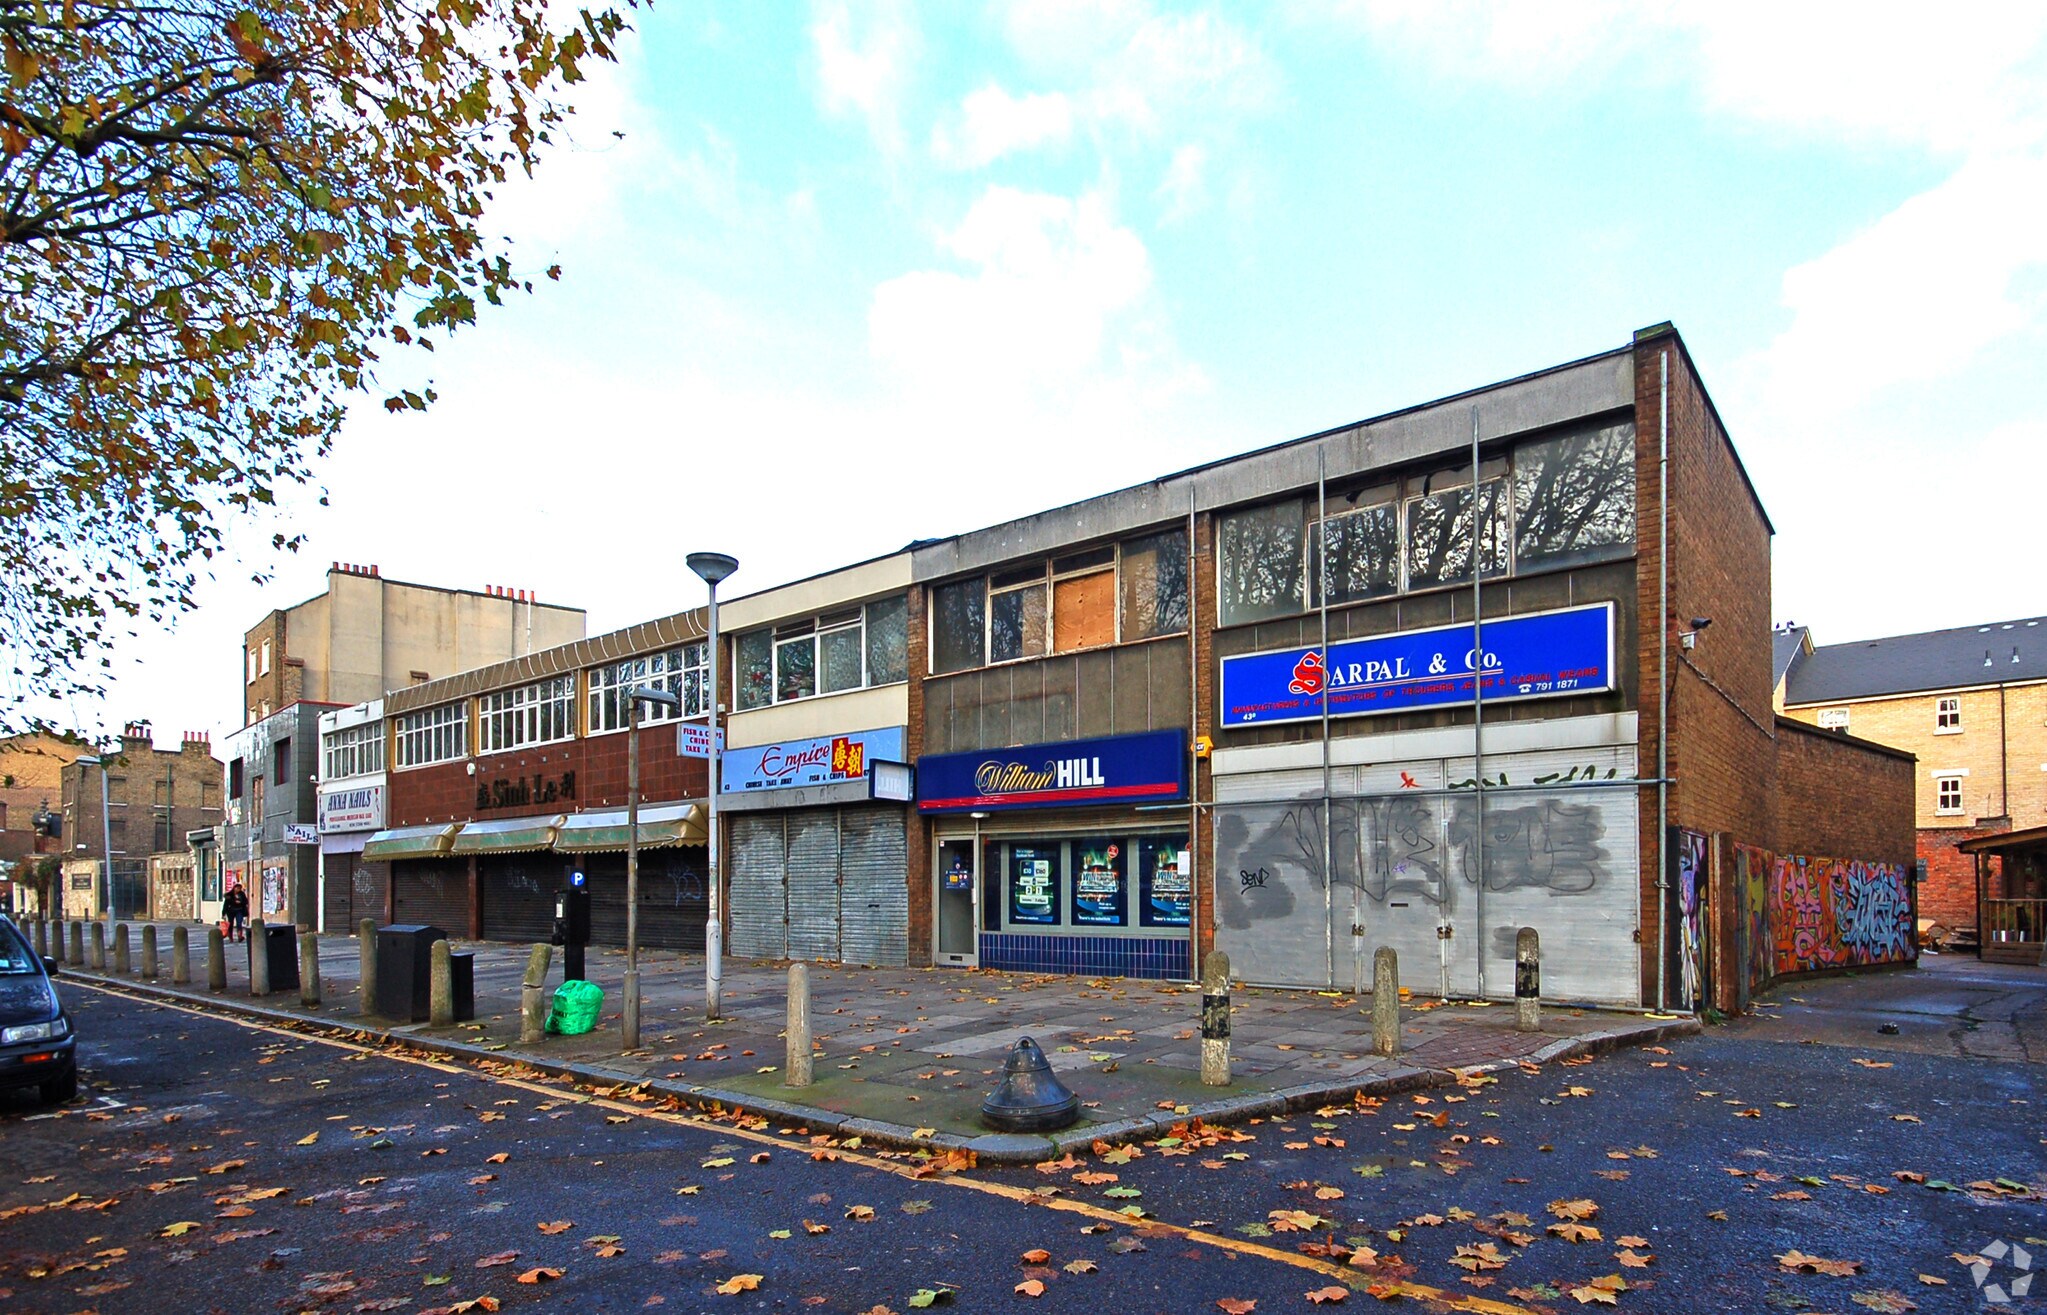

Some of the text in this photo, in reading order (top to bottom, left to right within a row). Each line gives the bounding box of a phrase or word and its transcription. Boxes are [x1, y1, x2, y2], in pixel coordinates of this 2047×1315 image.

[1288, 649, 1502, 695] SARPAL & Co.
[1536, 679, 1578, 691] 791 1871
[683, 728, 697, 736] FISH
[685, 745, 700, 753] TAKE
[754, 743, 830, 776] Empire
[975, 757, 1104, 795] William HILL
[327, 790, 371, 811] ANNA NAILS
[287, 824, 319, 842] NAILS
[574, 872, 583, 885] P
